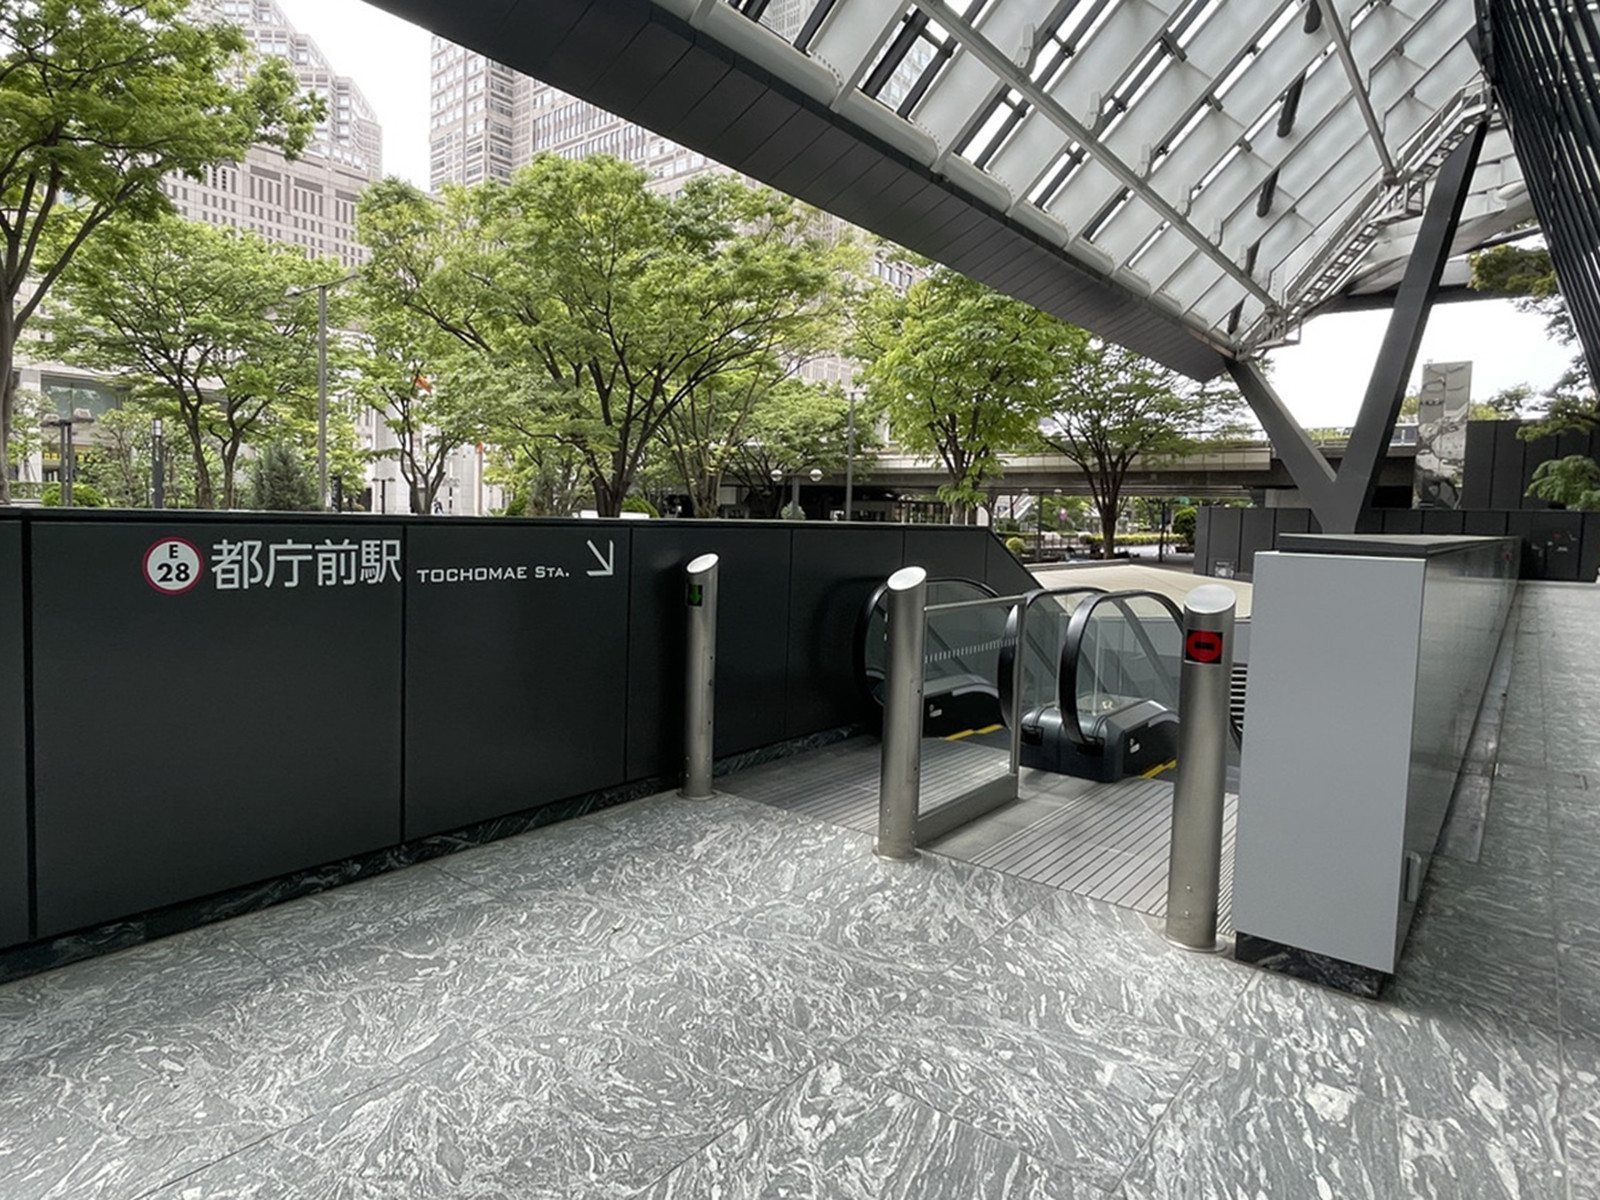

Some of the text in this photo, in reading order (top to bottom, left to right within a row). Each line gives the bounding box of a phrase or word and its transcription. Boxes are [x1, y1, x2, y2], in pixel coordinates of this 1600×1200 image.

[168, 544, 179, 559] E
[157, 562, 190, 582] 28
[211, 539, 402, 589] 都庁前駅
[416, 567, 527, 583] TOCHOMAE
